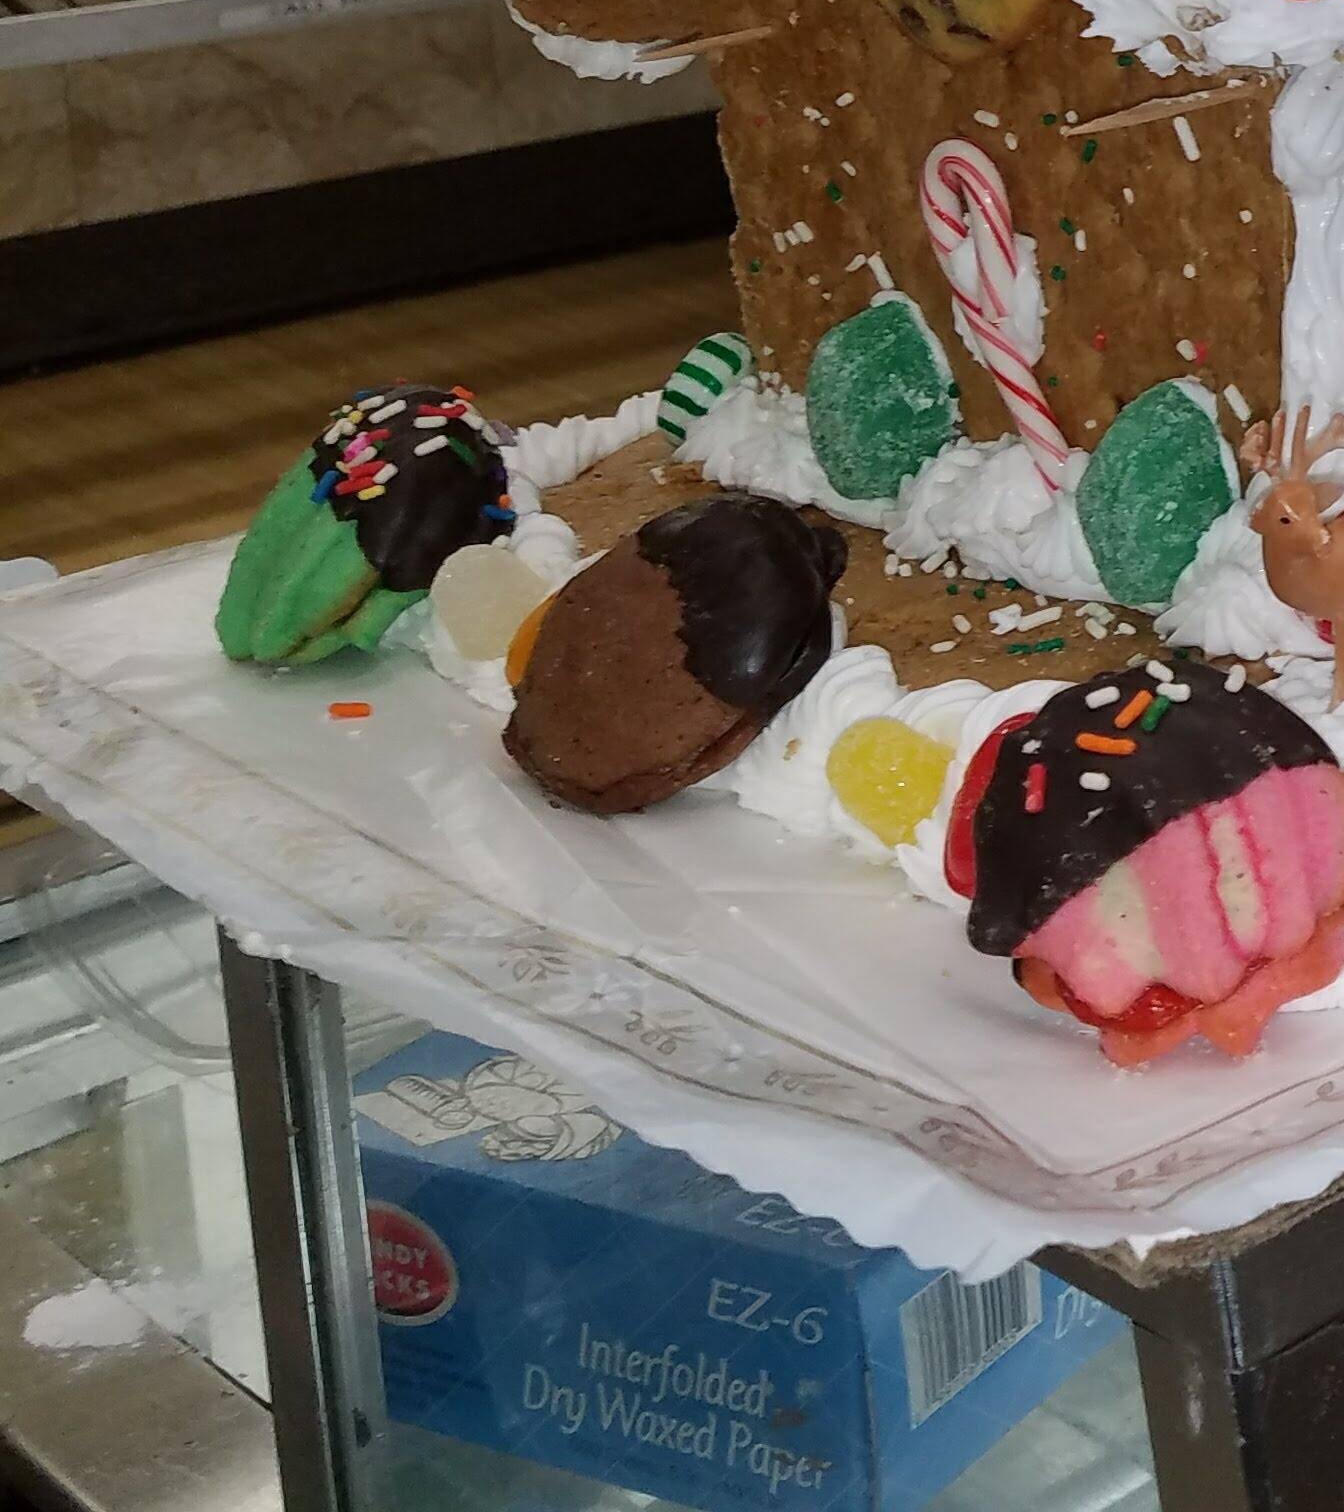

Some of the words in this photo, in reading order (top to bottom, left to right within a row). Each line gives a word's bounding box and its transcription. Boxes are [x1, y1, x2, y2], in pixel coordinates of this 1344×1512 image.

[375, 1239, 428, 1270] NDY
[382, 1270, 431, 1301] CKS
[707, 1277, 830, 1346] EZ-6
[577, 1321, 769, 1419] Interfolded
[522, 1363, 587, 1434] Dry
[598, 1382, 718, 1461] Waxed
[727, 1419, 833, 1496] Paper
